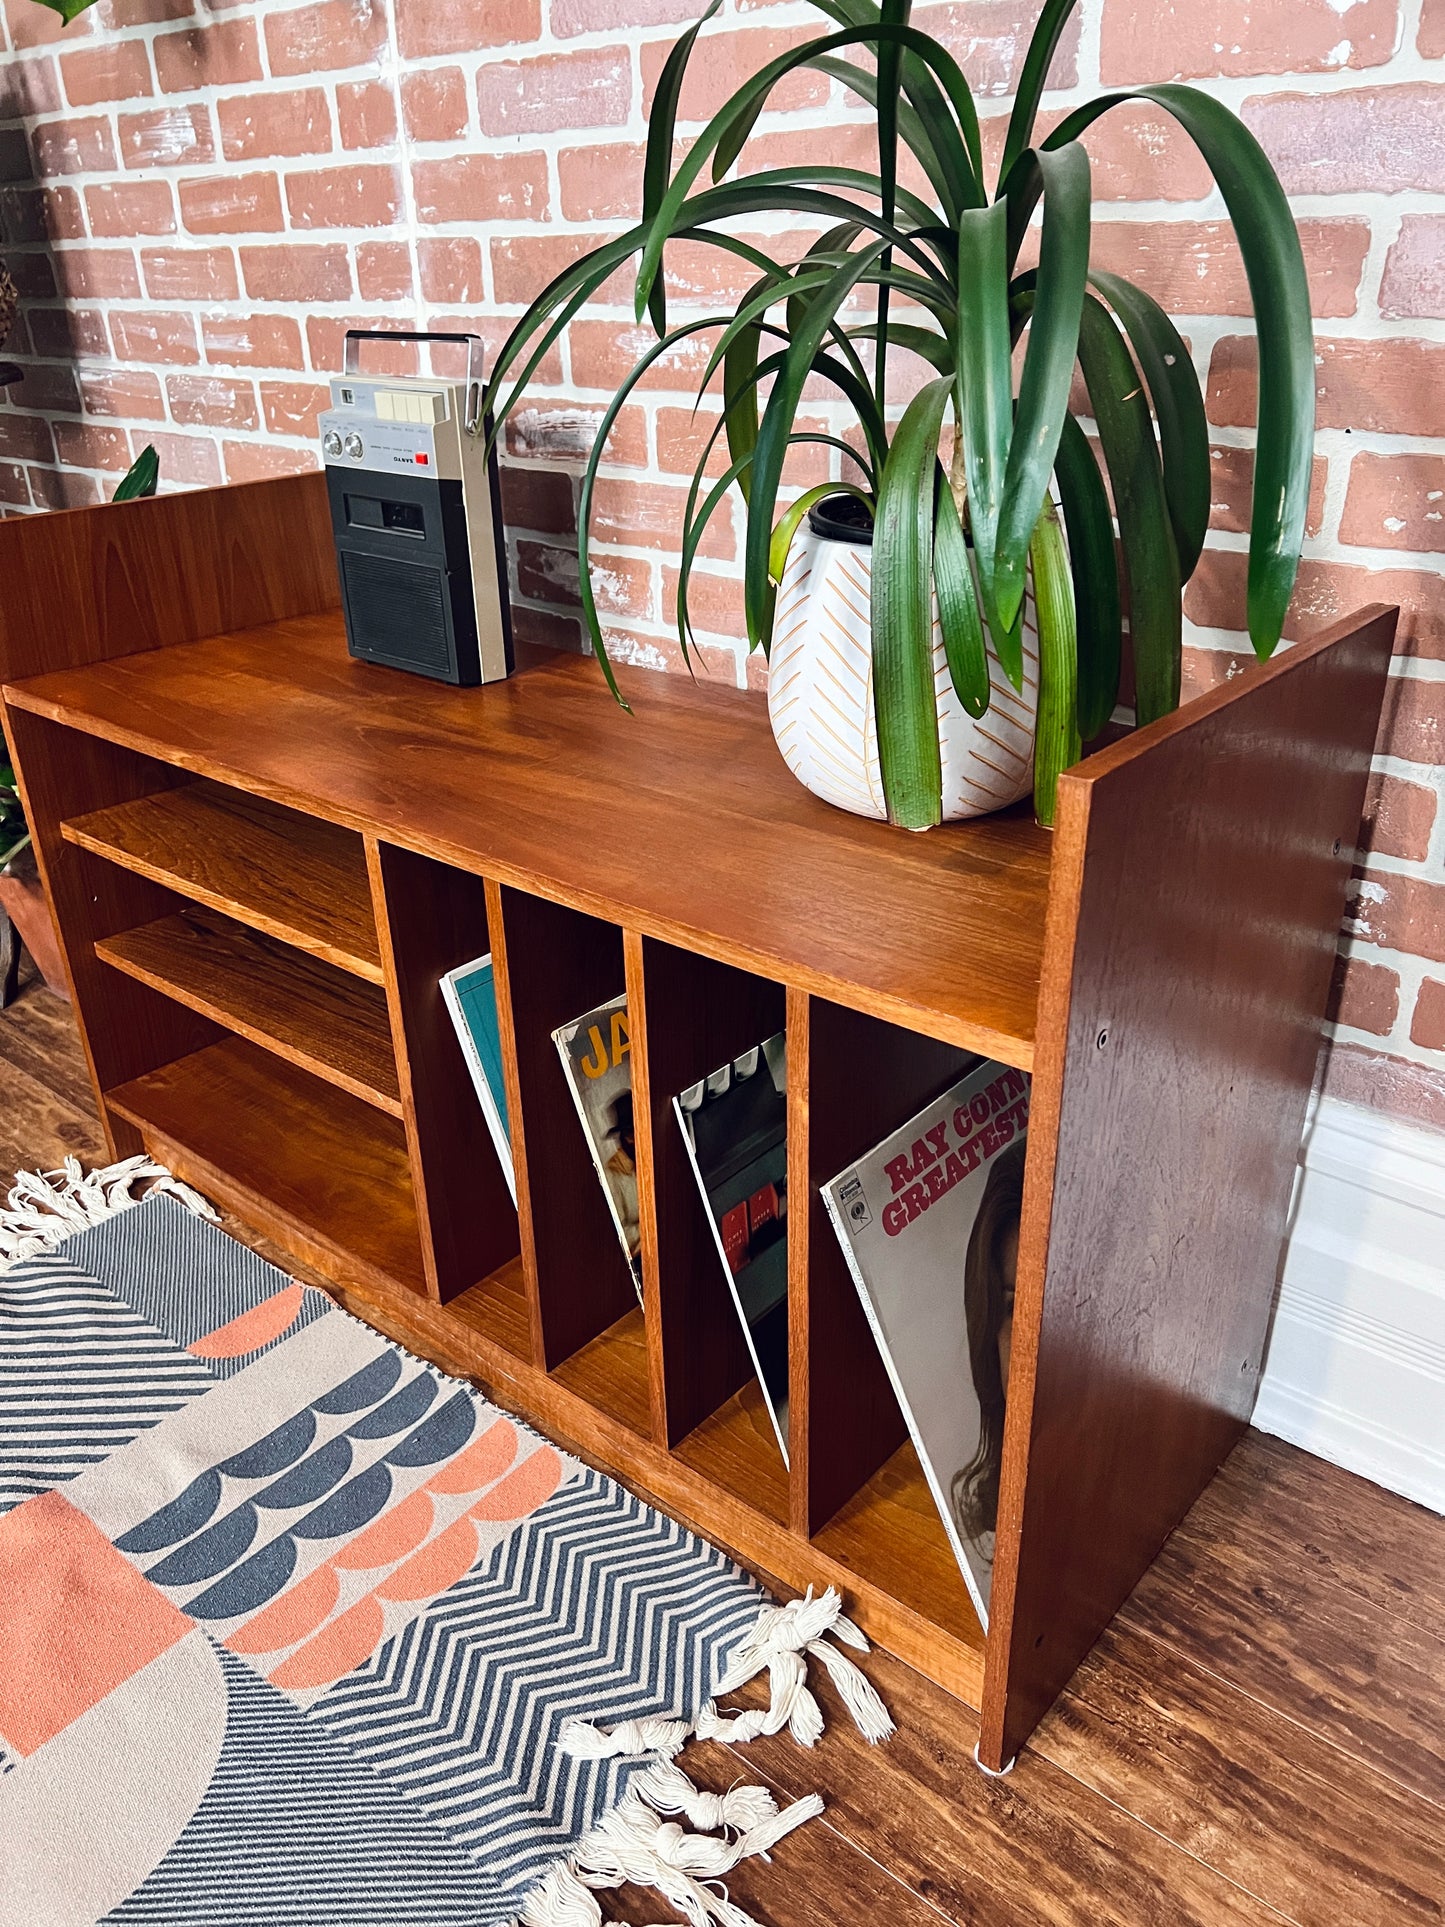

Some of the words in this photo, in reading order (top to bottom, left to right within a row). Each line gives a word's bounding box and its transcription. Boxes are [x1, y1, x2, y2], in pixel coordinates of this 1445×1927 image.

[393, 456, 414, 464] SANYO
[882, 1096, 1029, 1236] GREATEST
[883, 1120, 950, 1195] RAY
